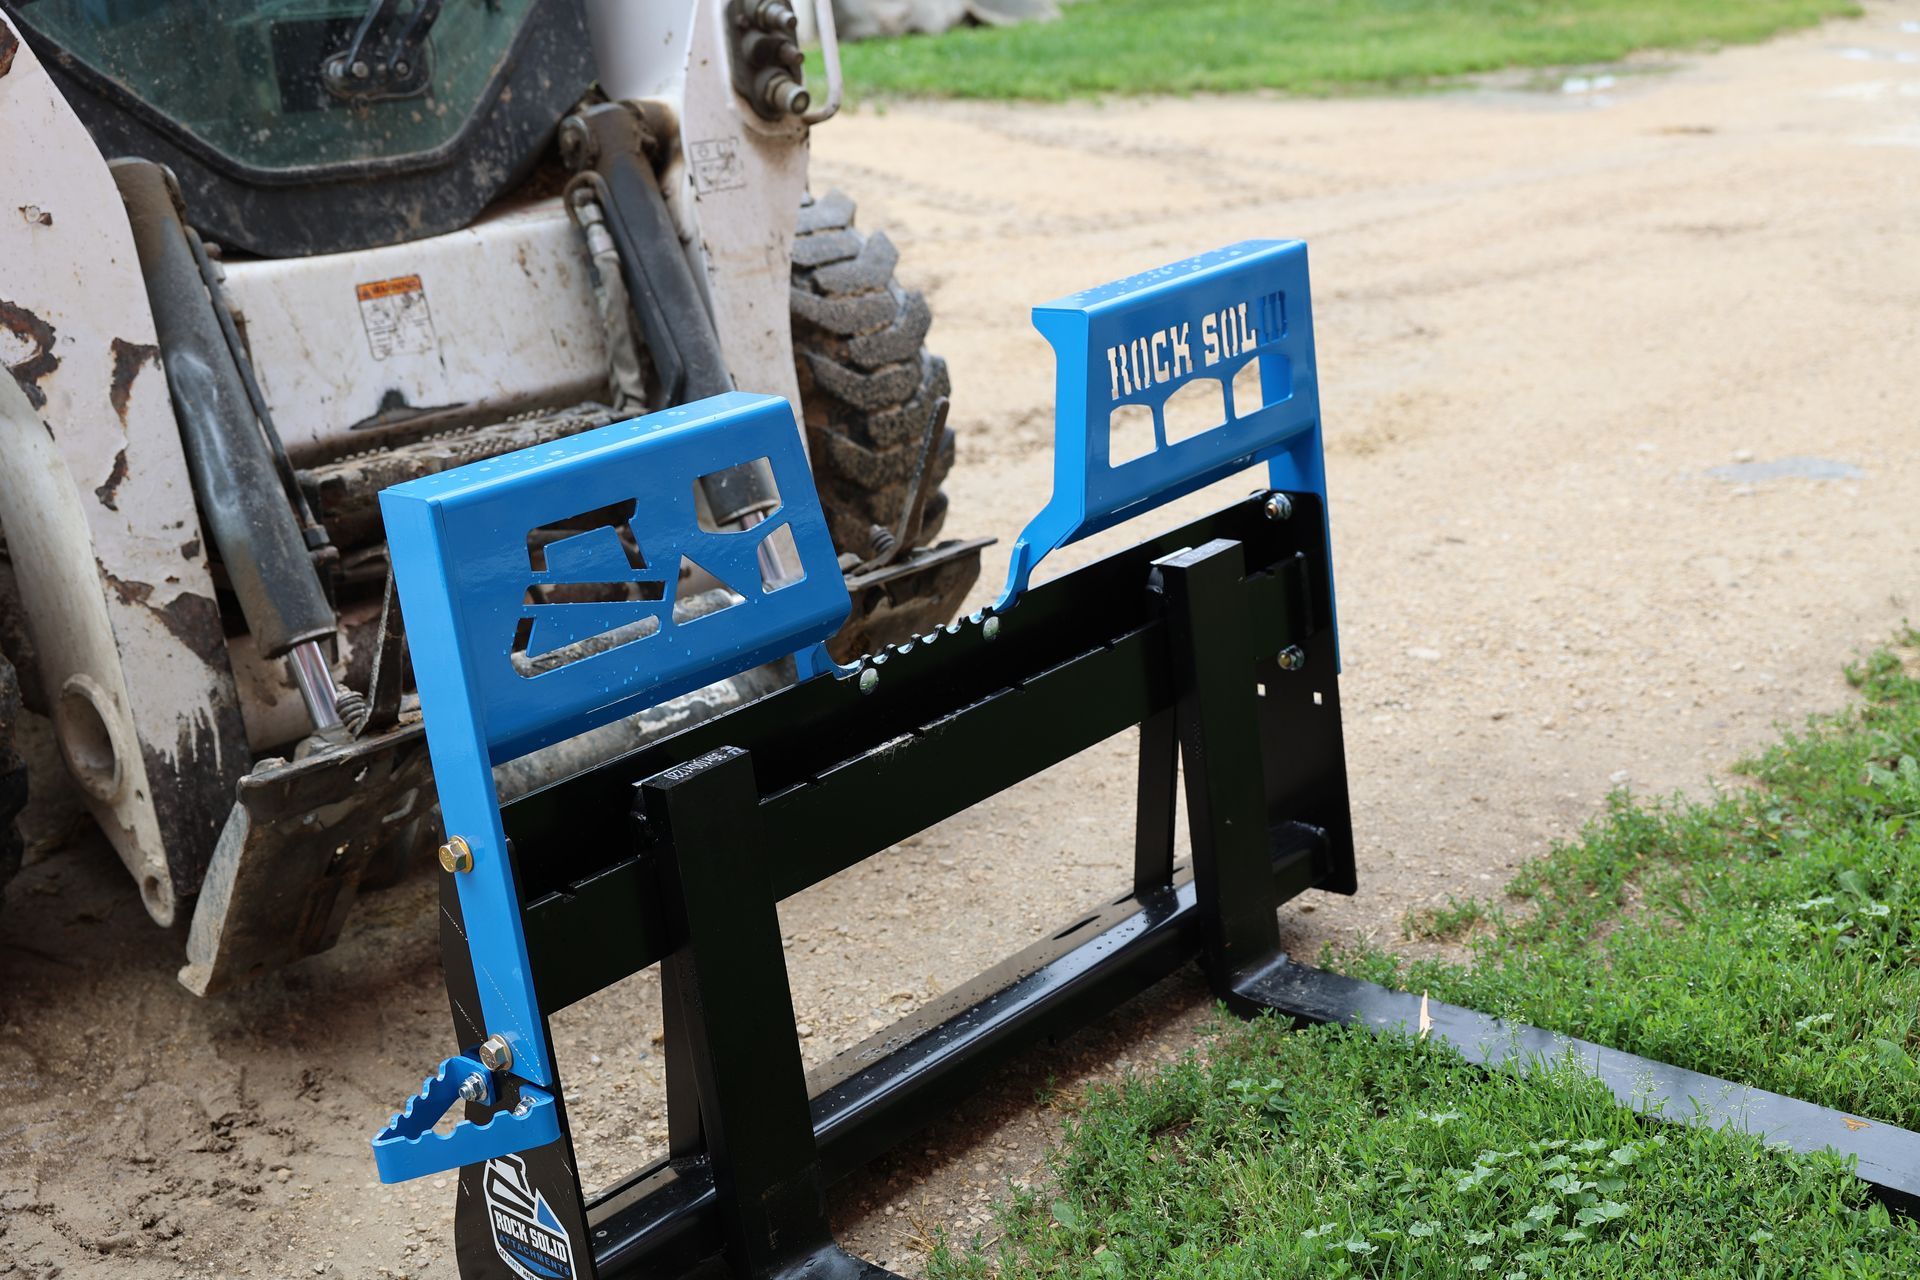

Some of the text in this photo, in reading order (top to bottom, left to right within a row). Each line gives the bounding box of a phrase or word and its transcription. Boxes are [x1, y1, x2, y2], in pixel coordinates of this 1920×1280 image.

[1107, 322, 1194, 400] ROCK
[493, 1209, 568, 1263] ROCK SOLID
[499, 1234, 571, 1276] ATTACHMENTS
